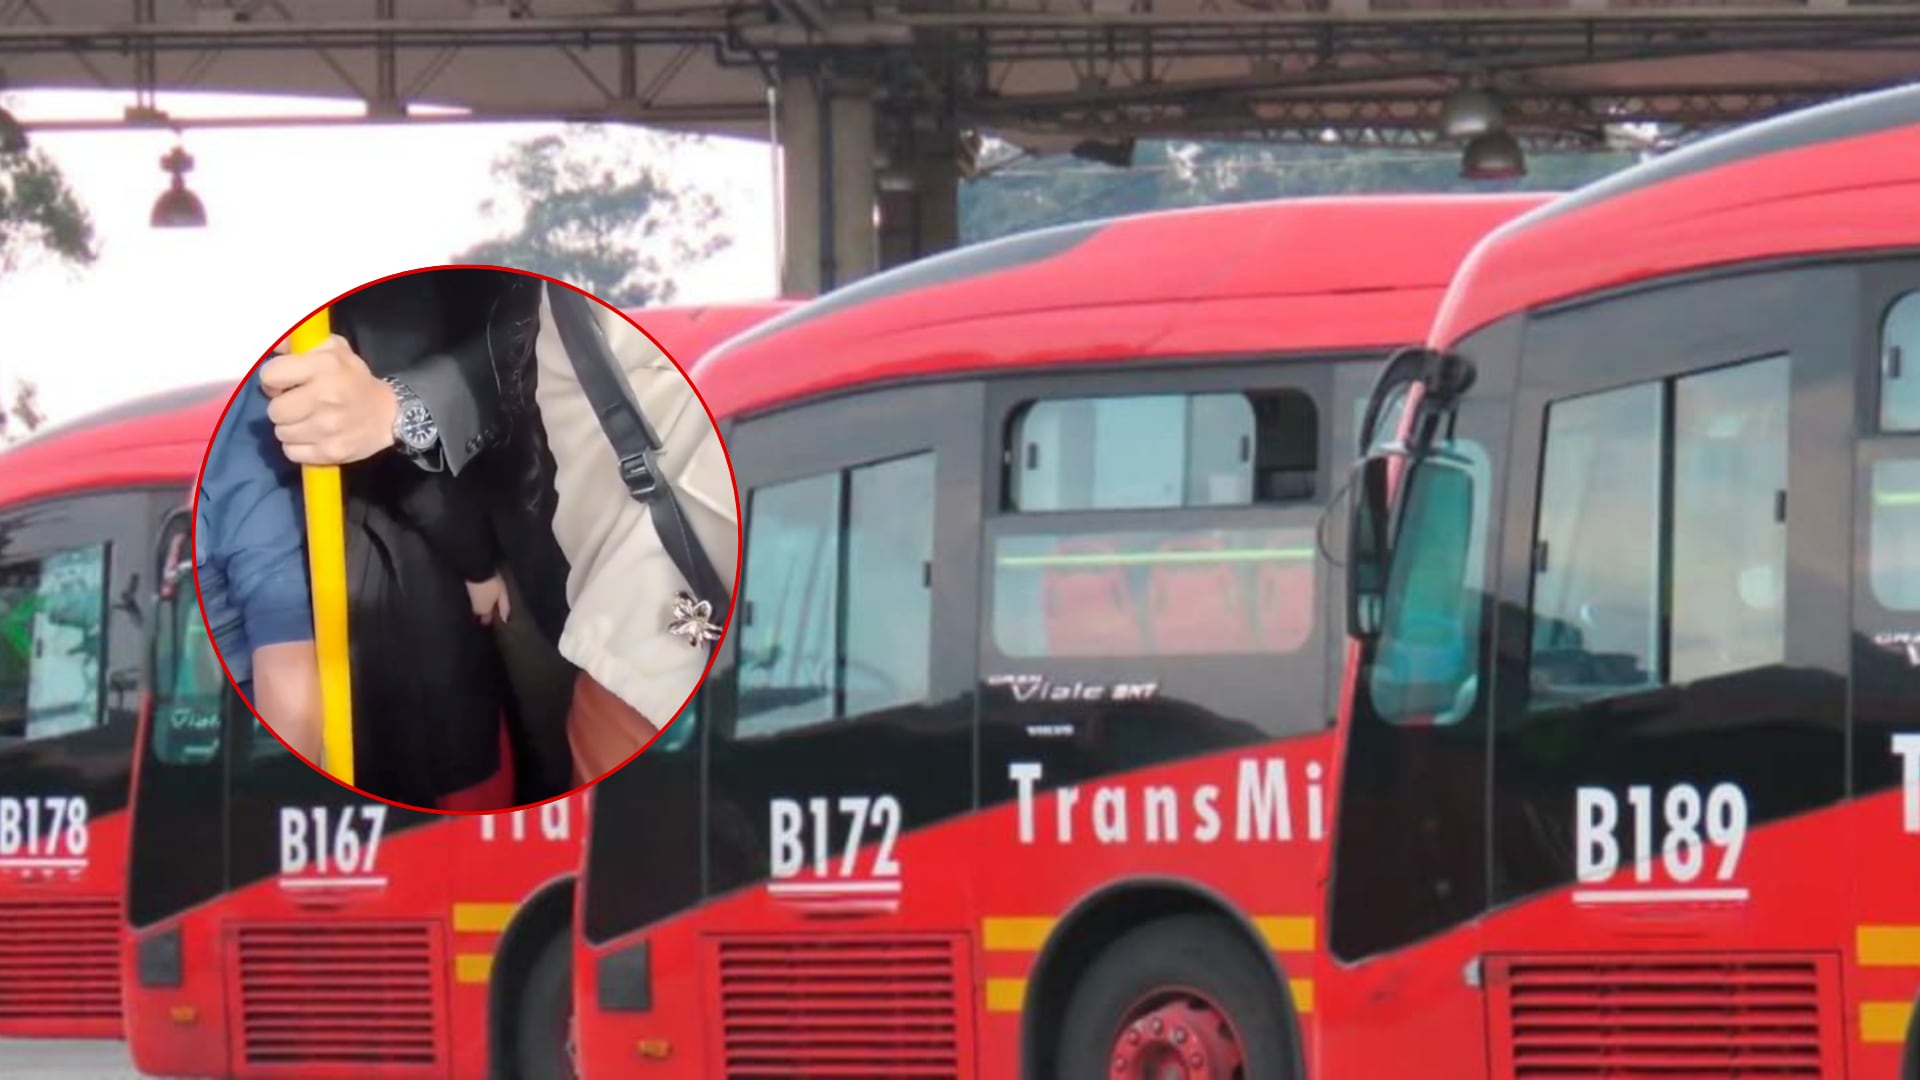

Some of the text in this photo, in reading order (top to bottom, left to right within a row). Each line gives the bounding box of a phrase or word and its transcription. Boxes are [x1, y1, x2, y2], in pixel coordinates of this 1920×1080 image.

[0, 796, 88, 855] B178
[280, 805, 387, 874] B167
[769, 795, 901, 878] B172
[1008, 757, 1323, 843] TransMi
[1576, 782, 1748, 883] B189
